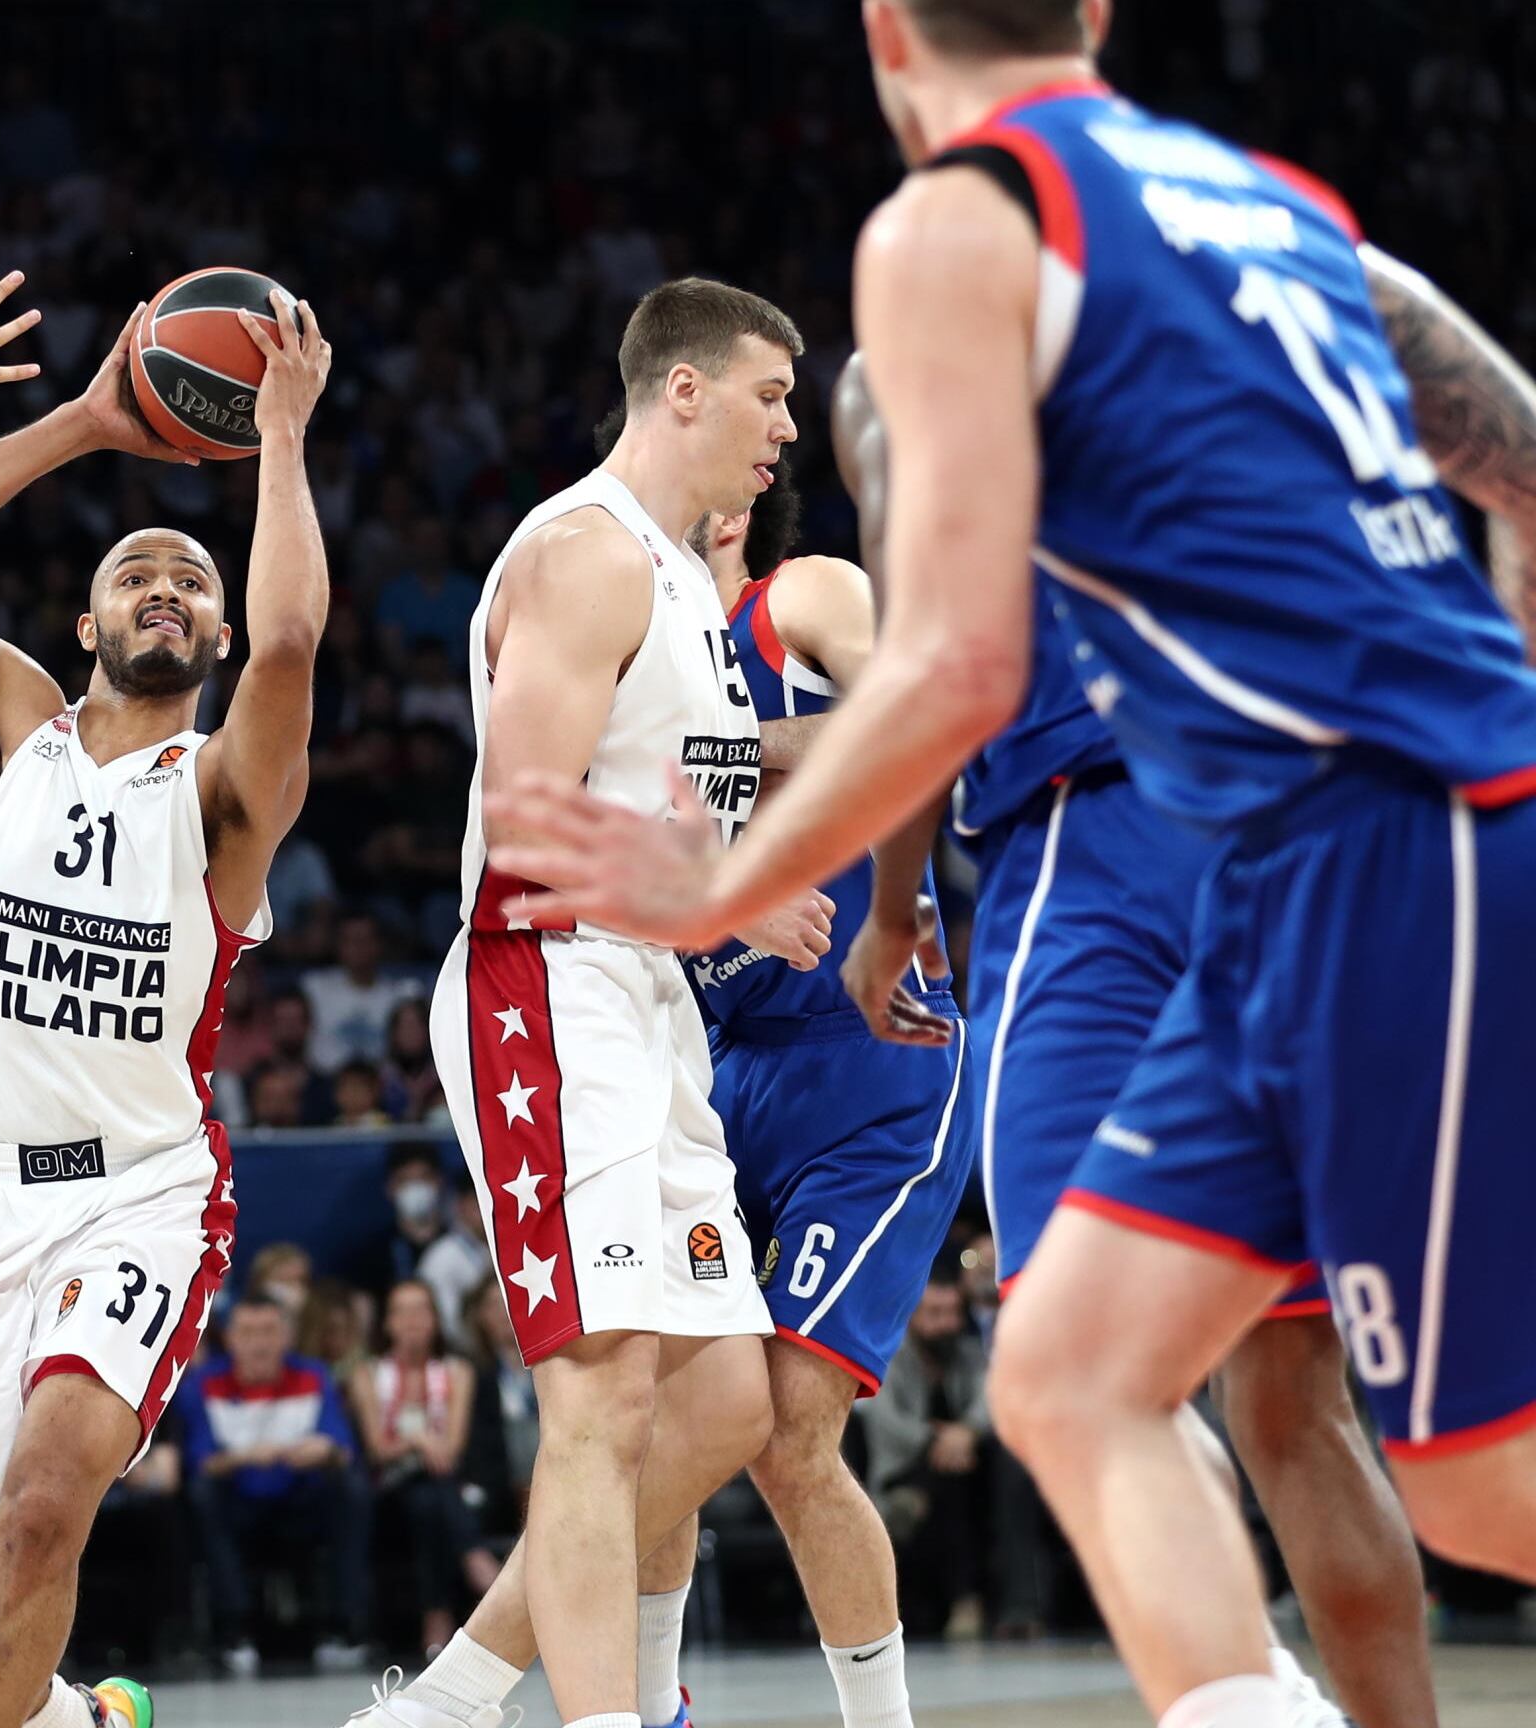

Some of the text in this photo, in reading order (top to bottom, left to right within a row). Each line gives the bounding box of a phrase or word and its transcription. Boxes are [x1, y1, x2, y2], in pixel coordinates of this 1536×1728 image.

[169, 378, 261, 437] SPALDI
[54, 802, 117, 887] 31
[59, 914, 170, 947] EXCHANGE
[715, 948, 771, 981] coren
[26, 1143, 99, 1179] OM
[593, 1259, 645, 1268] OAKLEY
[788, 1223, 835, 1299] 6
[106, 1262, 170, 1348] 31
